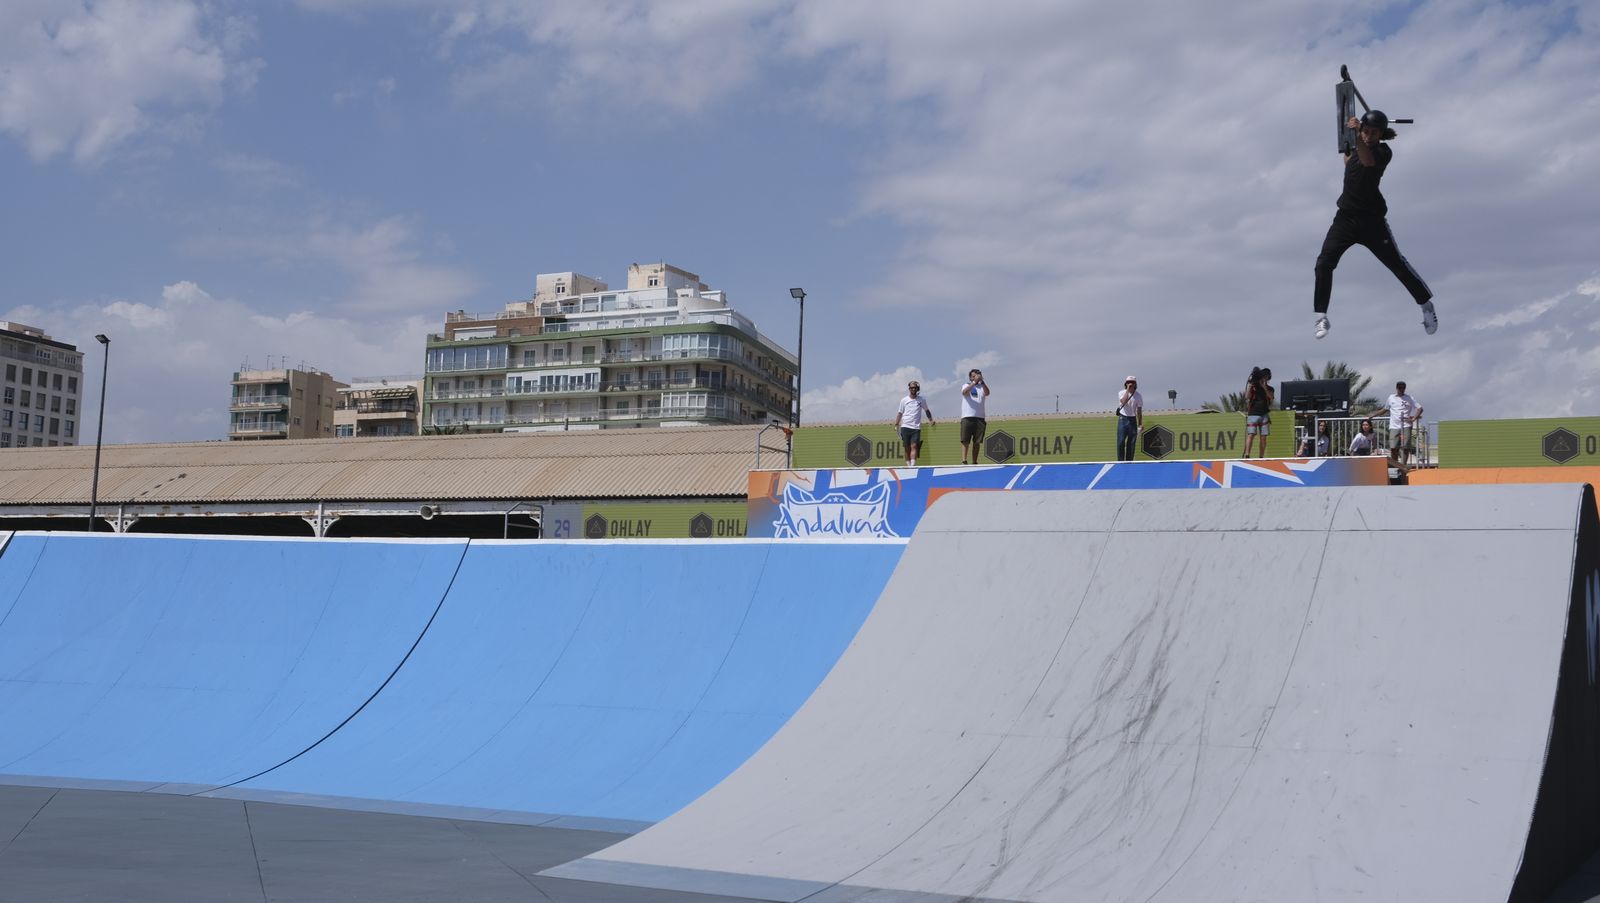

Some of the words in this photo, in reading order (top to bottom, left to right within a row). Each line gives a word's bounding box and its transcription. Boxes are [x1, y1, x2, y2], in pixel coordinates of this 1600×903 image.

[1019, 436, 1073, 456] OHLAY
[1179, 430, 1238, 452] OHLAY
[554, 519, 571, 538] 29
[611, 519, 652, 537] OHLAY
[774, 505, 890, 538] Andalucía
